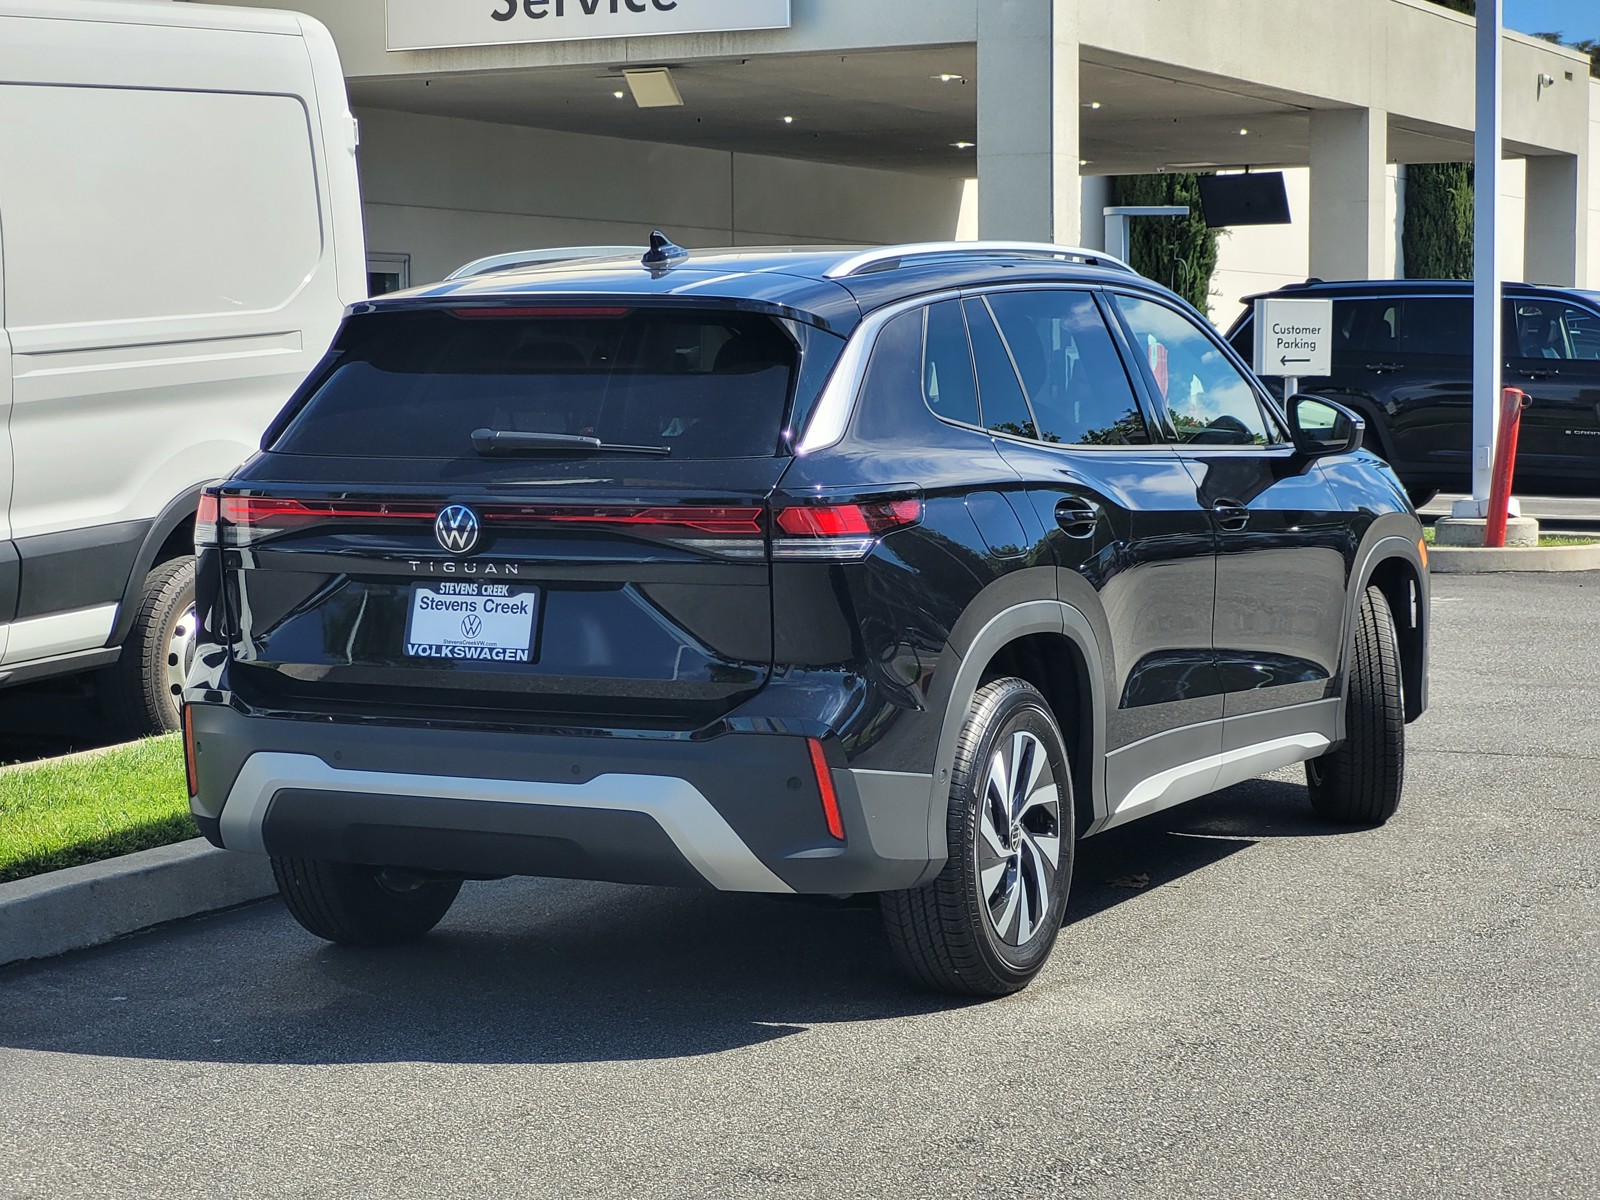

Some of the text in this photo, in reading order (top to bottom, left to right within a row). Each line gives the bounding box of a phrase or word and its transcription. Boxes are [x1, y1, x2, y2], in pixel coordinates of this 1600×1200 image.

[1272, 323, 1322, 335] Customer
[1276, 337, 1316, 352] Parking
[408, 561, 519, 574] TIGUAN
[439, 582, 509, 597] STEVENS CREEK
[419, 595, 529, 615] Stevens Creek
[442, 638, 498, 647] StevensCreekVW.com
[407, 643, 529, 662] VOLKSWAGEN
